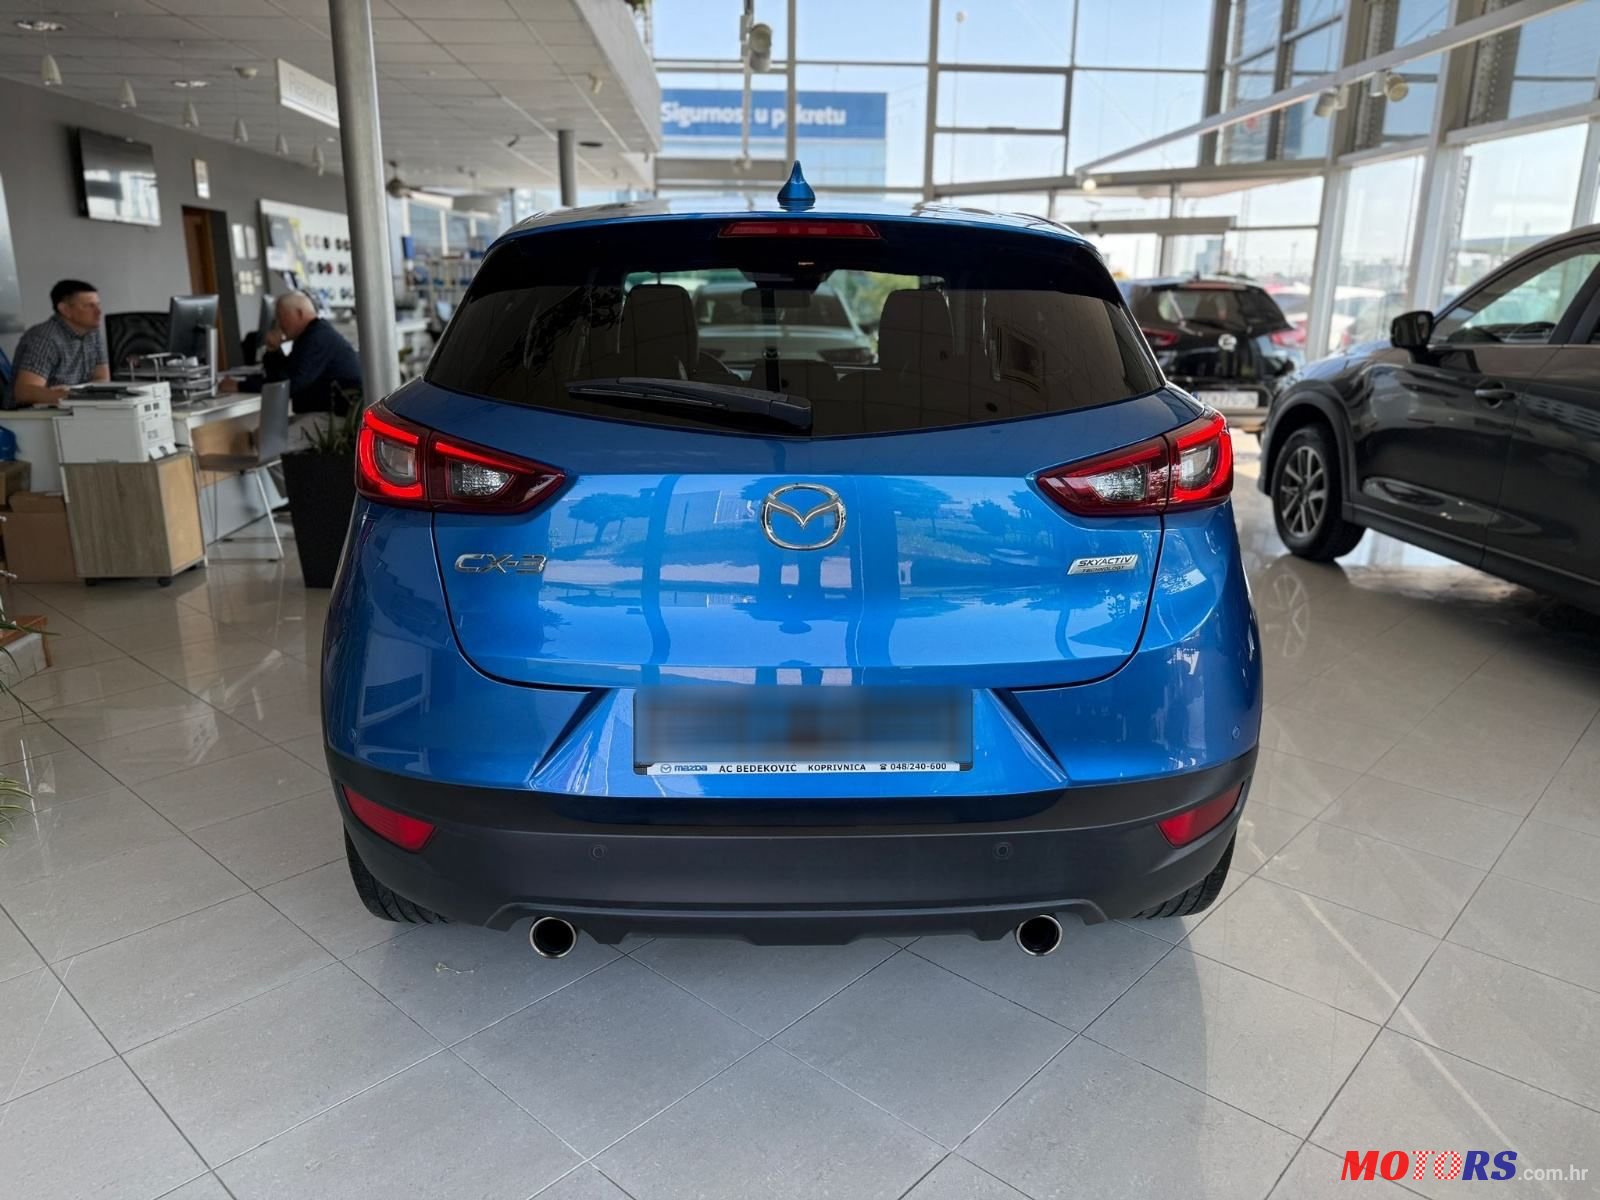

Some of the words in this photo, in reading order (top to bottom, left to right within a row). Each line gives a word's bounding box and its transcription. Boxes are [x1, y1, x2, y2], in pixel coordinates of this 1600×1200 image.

[660, 101, 750, 128] Sigurnos
[754, 108, 768, 124] u
[771, 104, 847, 129] pkretu
[455, 553, 547, 574] CX-3
[1077, 556, 1132, 567] SKYACTIV
[674, 764, 708, 772] mazda
[719, 765, 733, 773] AC
[736, 763, 797, 773] BEDEKOVIĆ
[808, 763, 867, 771] KOPRIVNICA
[890, 762, 947, 771] 048/240-600
